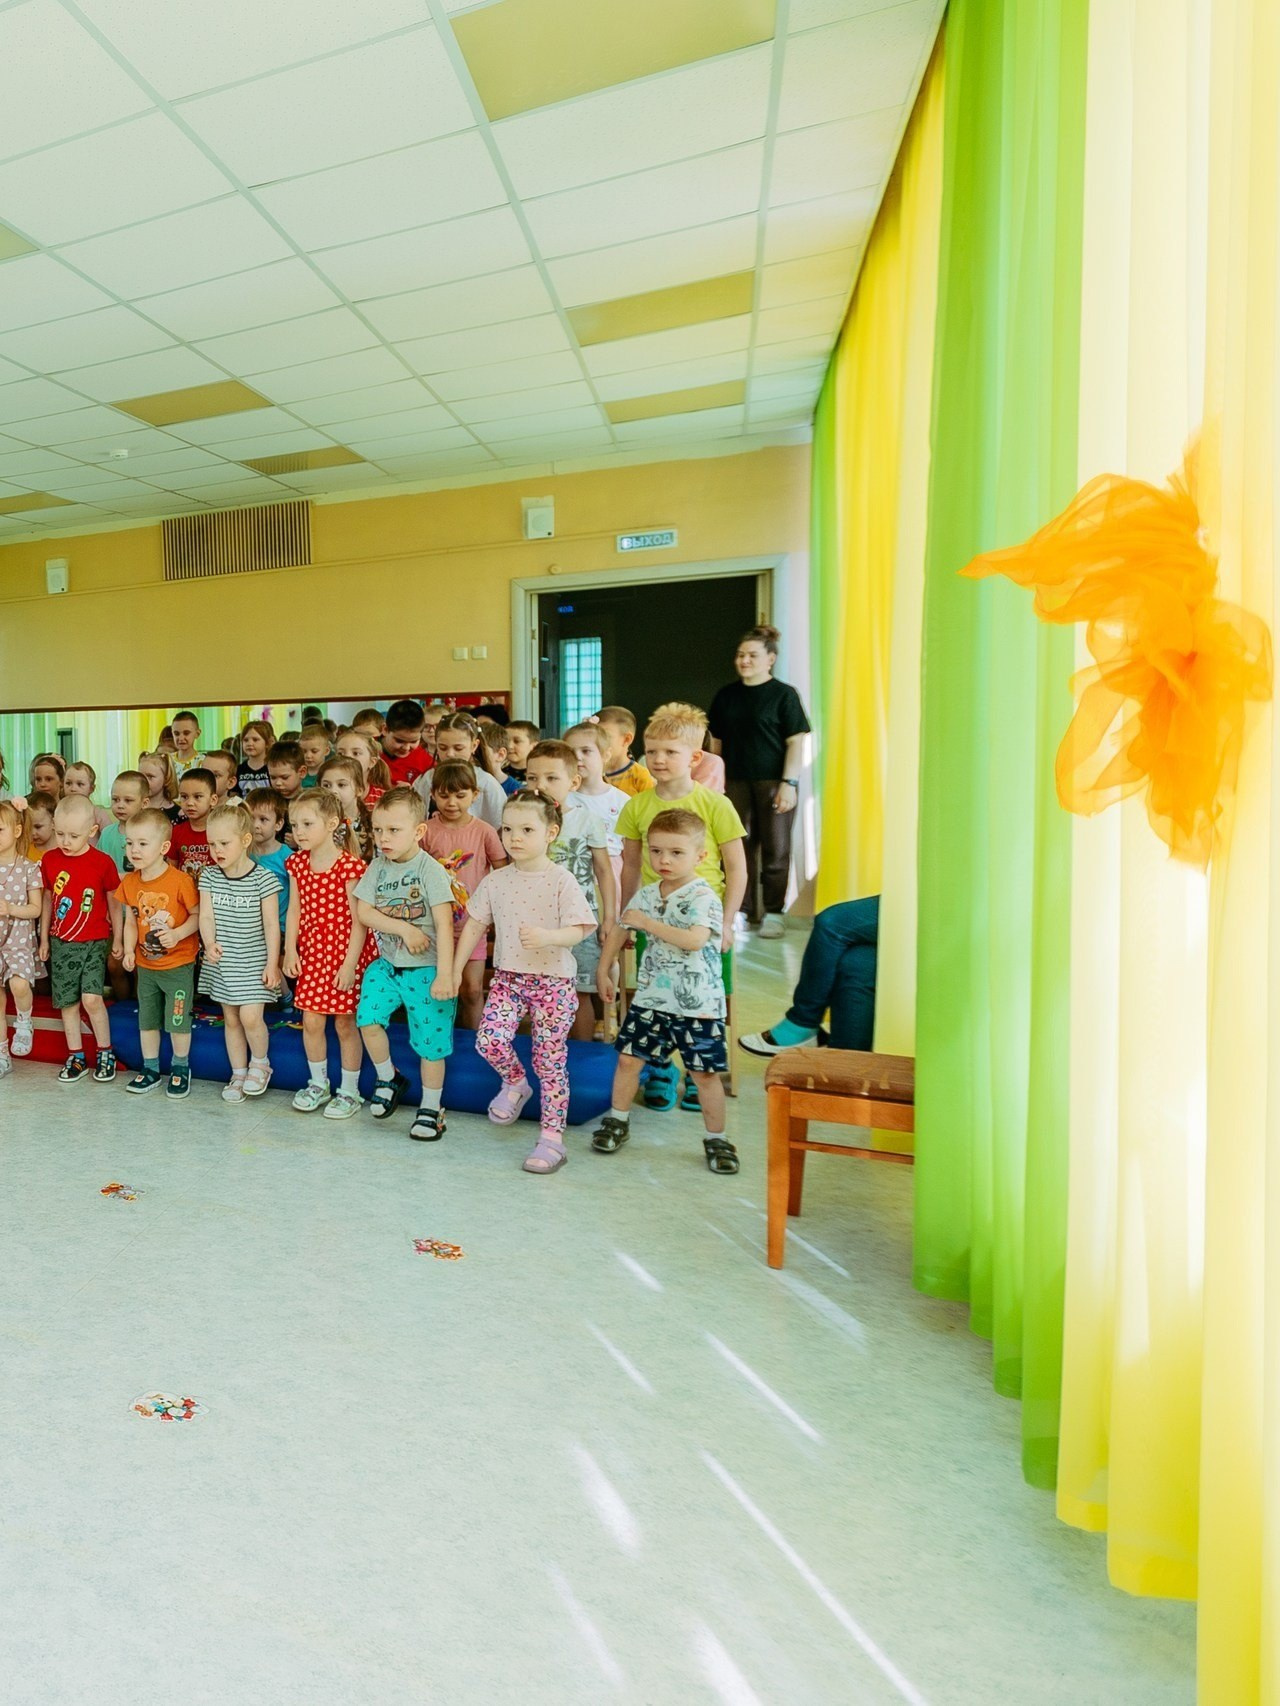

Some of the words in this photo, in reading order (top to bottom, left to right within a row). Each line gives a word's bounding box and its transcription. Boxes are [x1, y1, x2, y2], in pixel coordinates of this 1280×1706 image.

[621, 533, 673, 549] ВЫХОД
[189, 845, 209, 853] GOLF
[376, 879, 399, 892] cing
[212, 893, 252, 908] HAPPY
